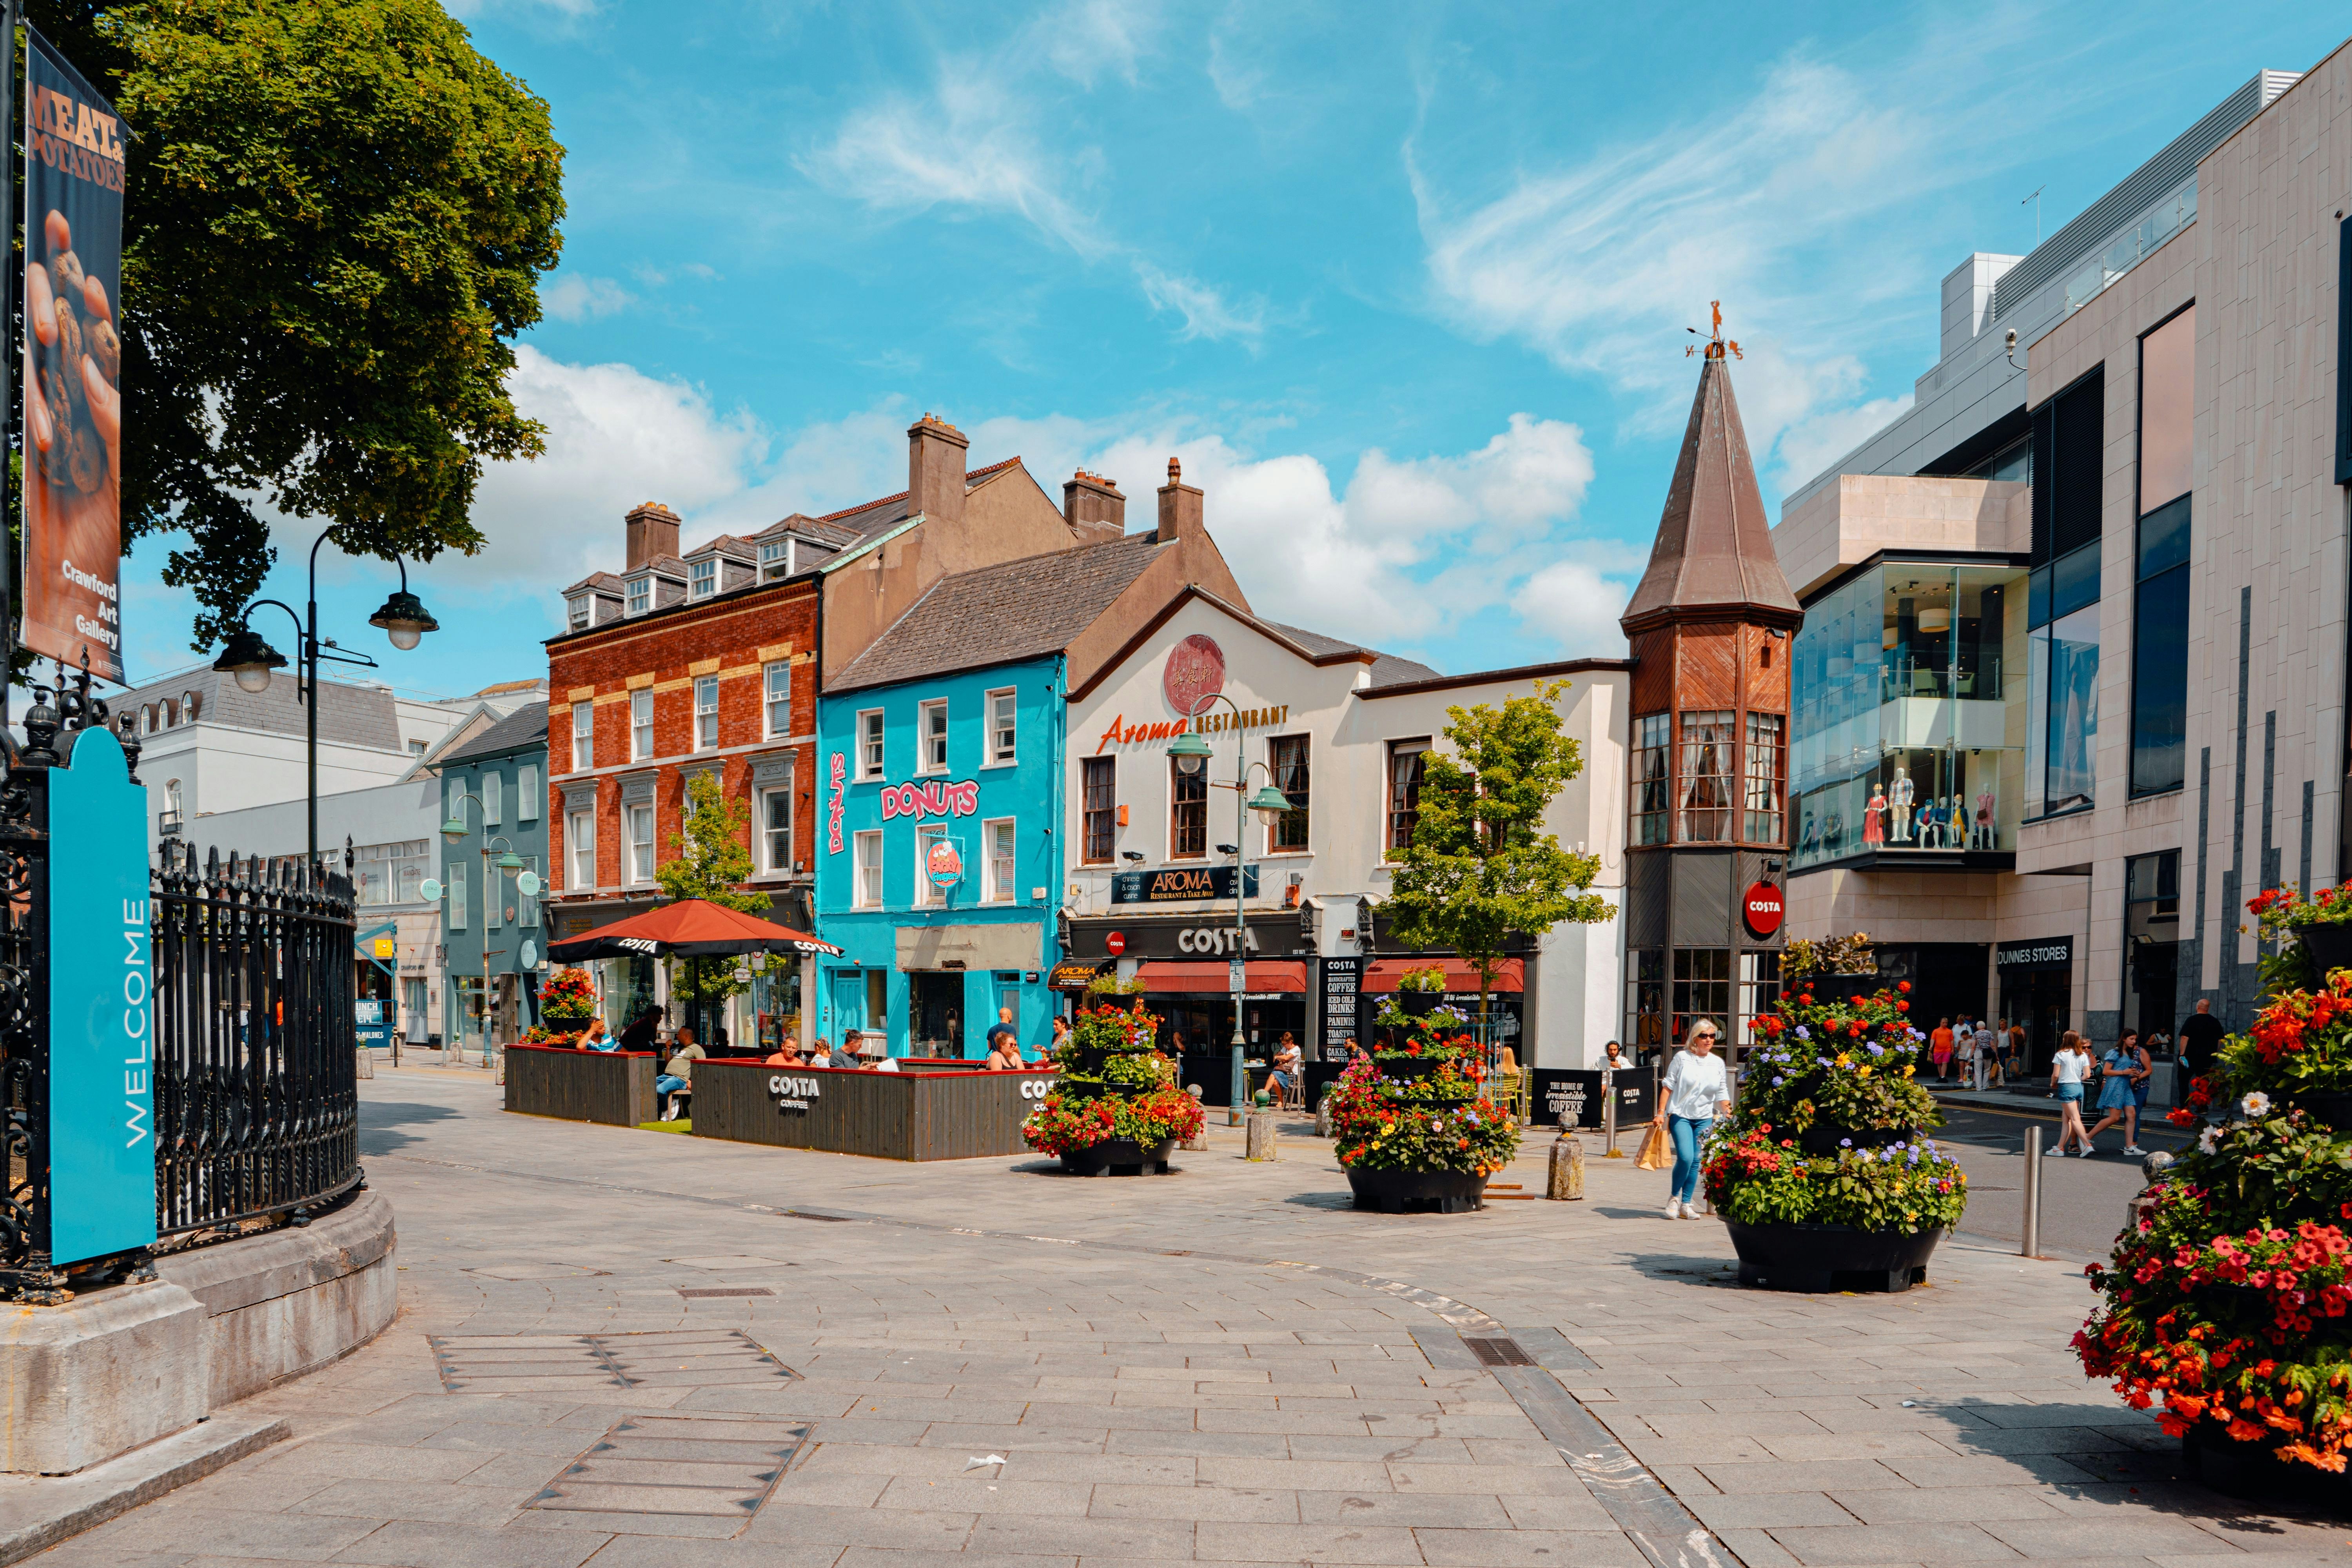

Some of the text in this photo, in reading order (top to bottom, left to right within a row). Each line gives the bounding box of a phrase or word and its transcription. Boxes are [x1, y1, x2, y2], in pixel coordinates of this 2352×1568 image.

[27, 80, 124, 164] MEAT &
[27, 128, 125, 195] POTATOES
[63, 559, 117, 602] Crawford
[98, 601, 118, 625] Art
[76, 614, 118, 650] Gallery
[1096, 705, 1289, 755] Aroma RESTAURANT
[828, 751, 846, 856] DONUTS
[880, 778, 981, 822] DONUTS
[932, 872, 959, 882] Fingers
[1151, 870, 1213, 891] AROMA
[1749, 901, 1780, 913] COSTA
[786, 911, 791, 922] 2
[618, 938, 657, 953] COSTA
[1178, 927, 1259, 955] COSTA
[794, 941, 839, 957] COSTA
[1998, 942, 2067, 964] DUNNES STORES
[1328, 961, 1356, 970] COSTA
[1328, 983, 1356, 993] COFFEE
[356, 1002, 377, 1011] UNCH
[1328, 1004, 1355, 1013] DRINKS
[124, 898, 147, 1149] WELCOME
[1327, 1017, 1355, 1026] PANINIS
[1327, 1048, 1348, 1056] CAKES
[769, 1076, 820, 1098] COSTA
[1623, 1089, 1640, 1097] COSTA
[1546, 1090, 1587, 1101] irresistible
[780, 1099, 808, 1109] COFFEE
[1549, 1100, 1583, 1114] COFFEE
